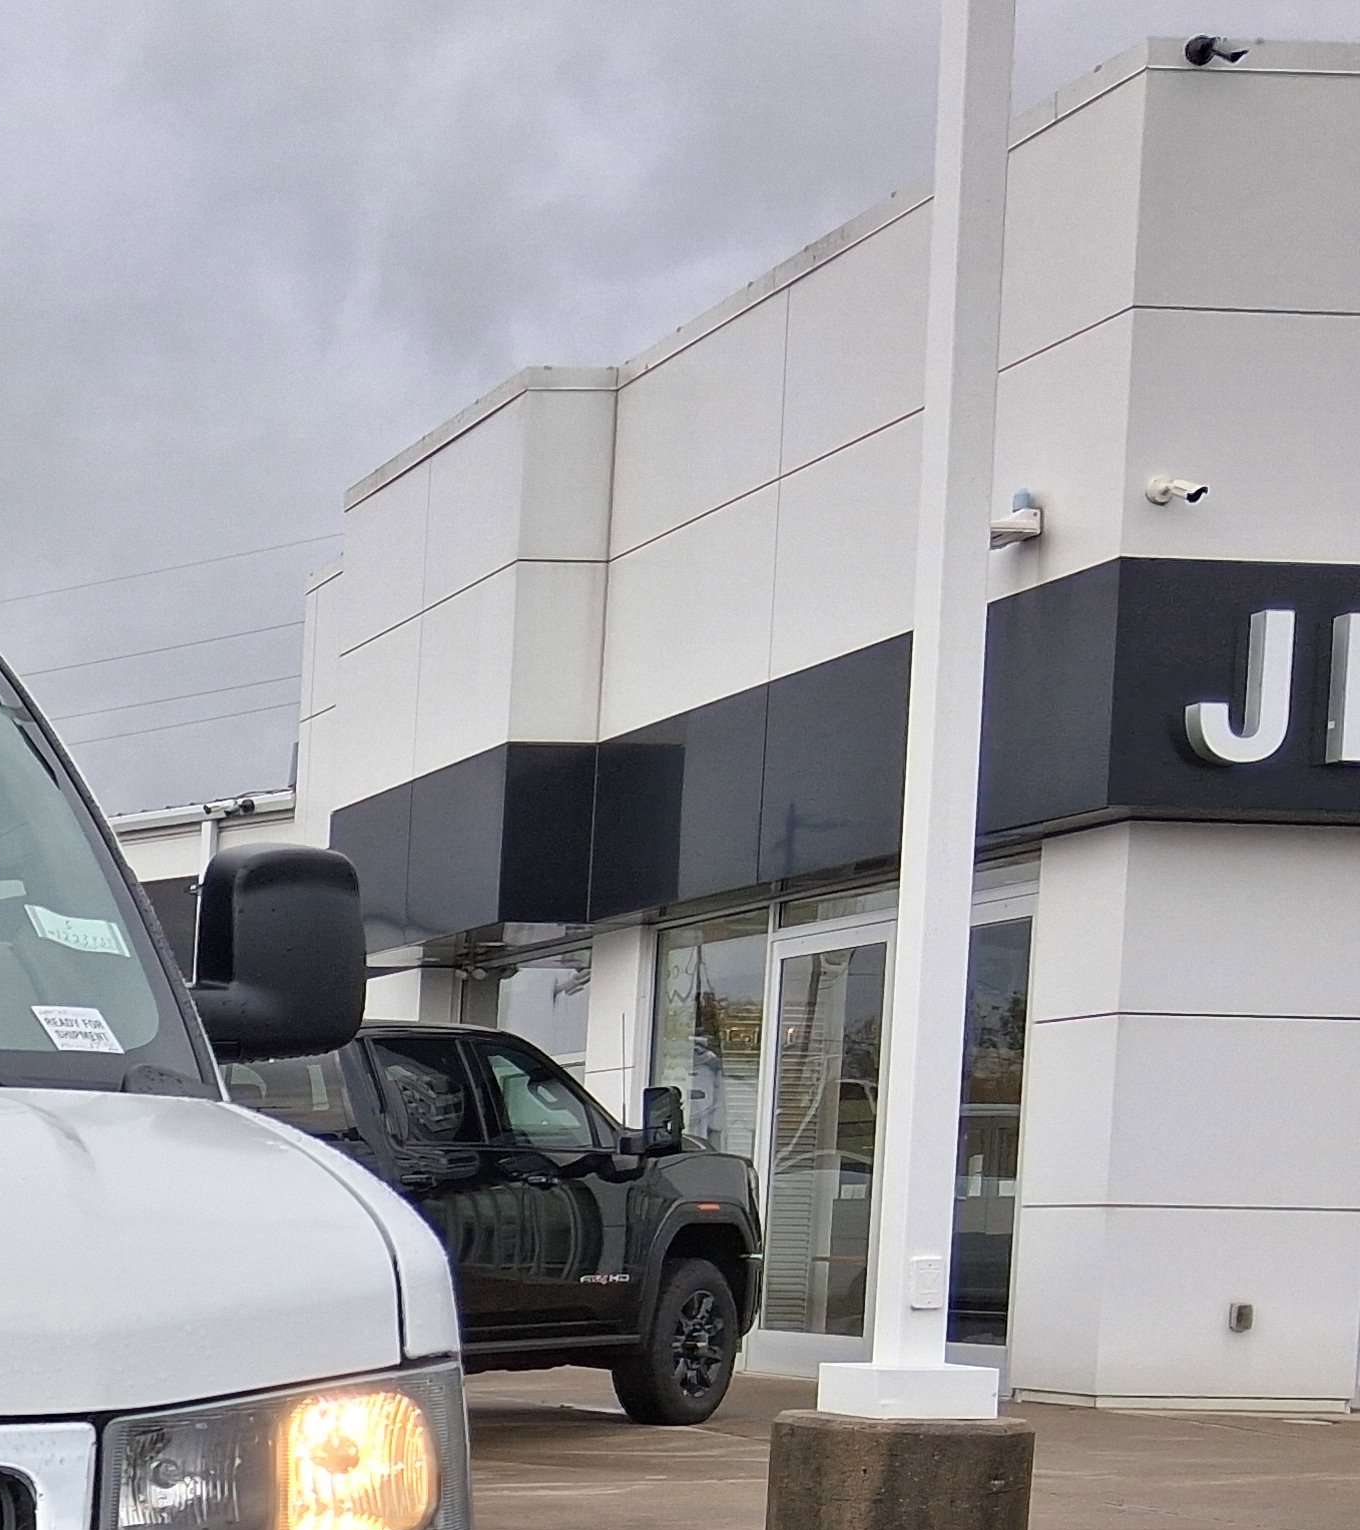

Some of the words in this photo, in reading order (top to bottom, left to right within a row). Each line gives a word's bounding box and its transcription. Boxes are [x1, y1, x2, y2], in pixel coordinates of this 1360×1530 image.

[44, 1017, 79, 1027] READY
[81, 1018, 105, 1029] FOR
[55, 1029, 109, 1042] SHIPMENT
